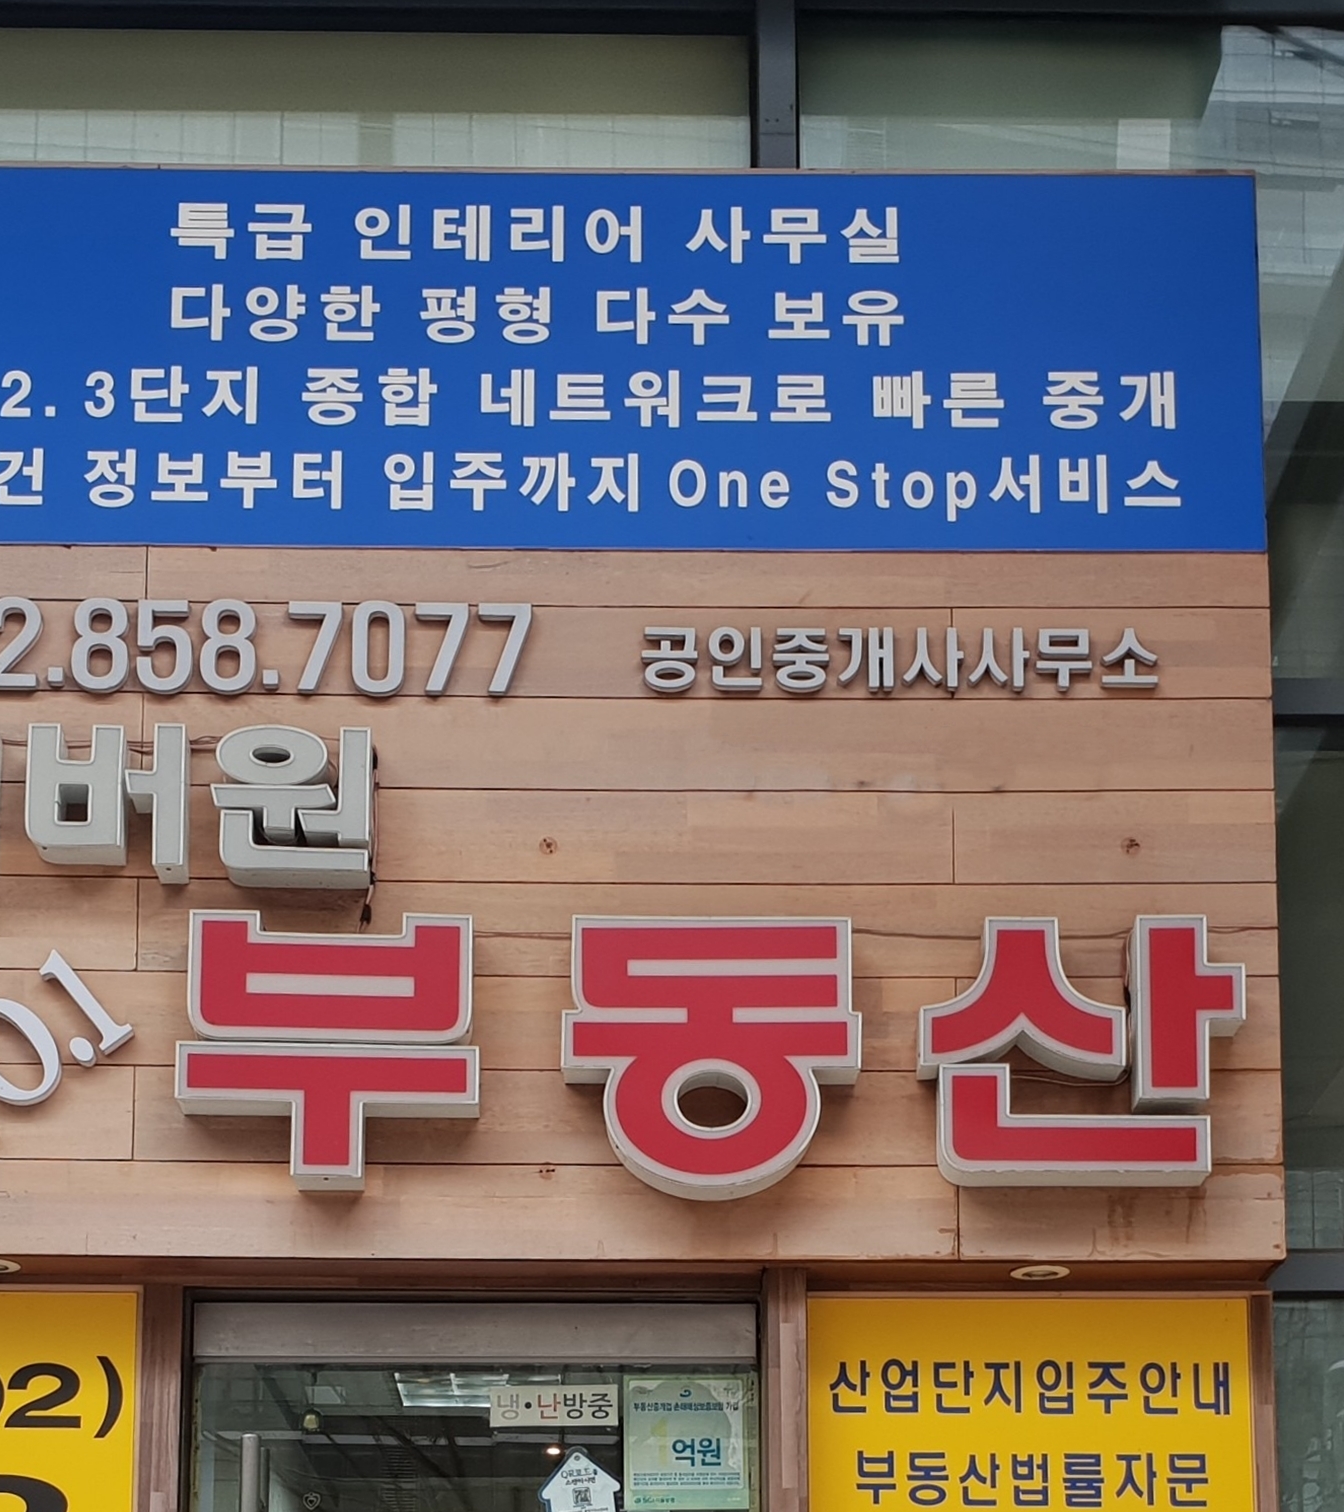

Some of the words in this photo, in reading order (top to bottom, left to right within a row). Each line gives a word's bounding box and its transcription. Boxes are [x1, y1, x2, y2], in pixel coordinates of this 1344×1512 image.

[167, 201, 315, 264] 특급
[352, 206, 646, 264] 인테리어
[685, 205, 904, 265] 사무실
[167, 283, 383, 346] 다양한
[418, 288, 554, 347] 평형
[593, 286, 732, 347] 다수
[767, 288, 908, 347] 보유
[300, 369, 439, 429] 종합
[477, 369, 834, 429] 네트워크로
[871, 369, 1006, 429] 빠른
[1042, 369, 1178, 429] 중개
[83, 446, 346, 510] 정보부터
[384, 450, 643, 511] 입주까지
[669, 454, 791, 510] One
[640, 623, 1160, 695] 공인중개사사무소
[175, 909, 1245, 1200] 부동산
[829, 1358, 1230, 1416] 산업단지입주안내
[855, 1450, 1210, 1508] 부동산법률자문
